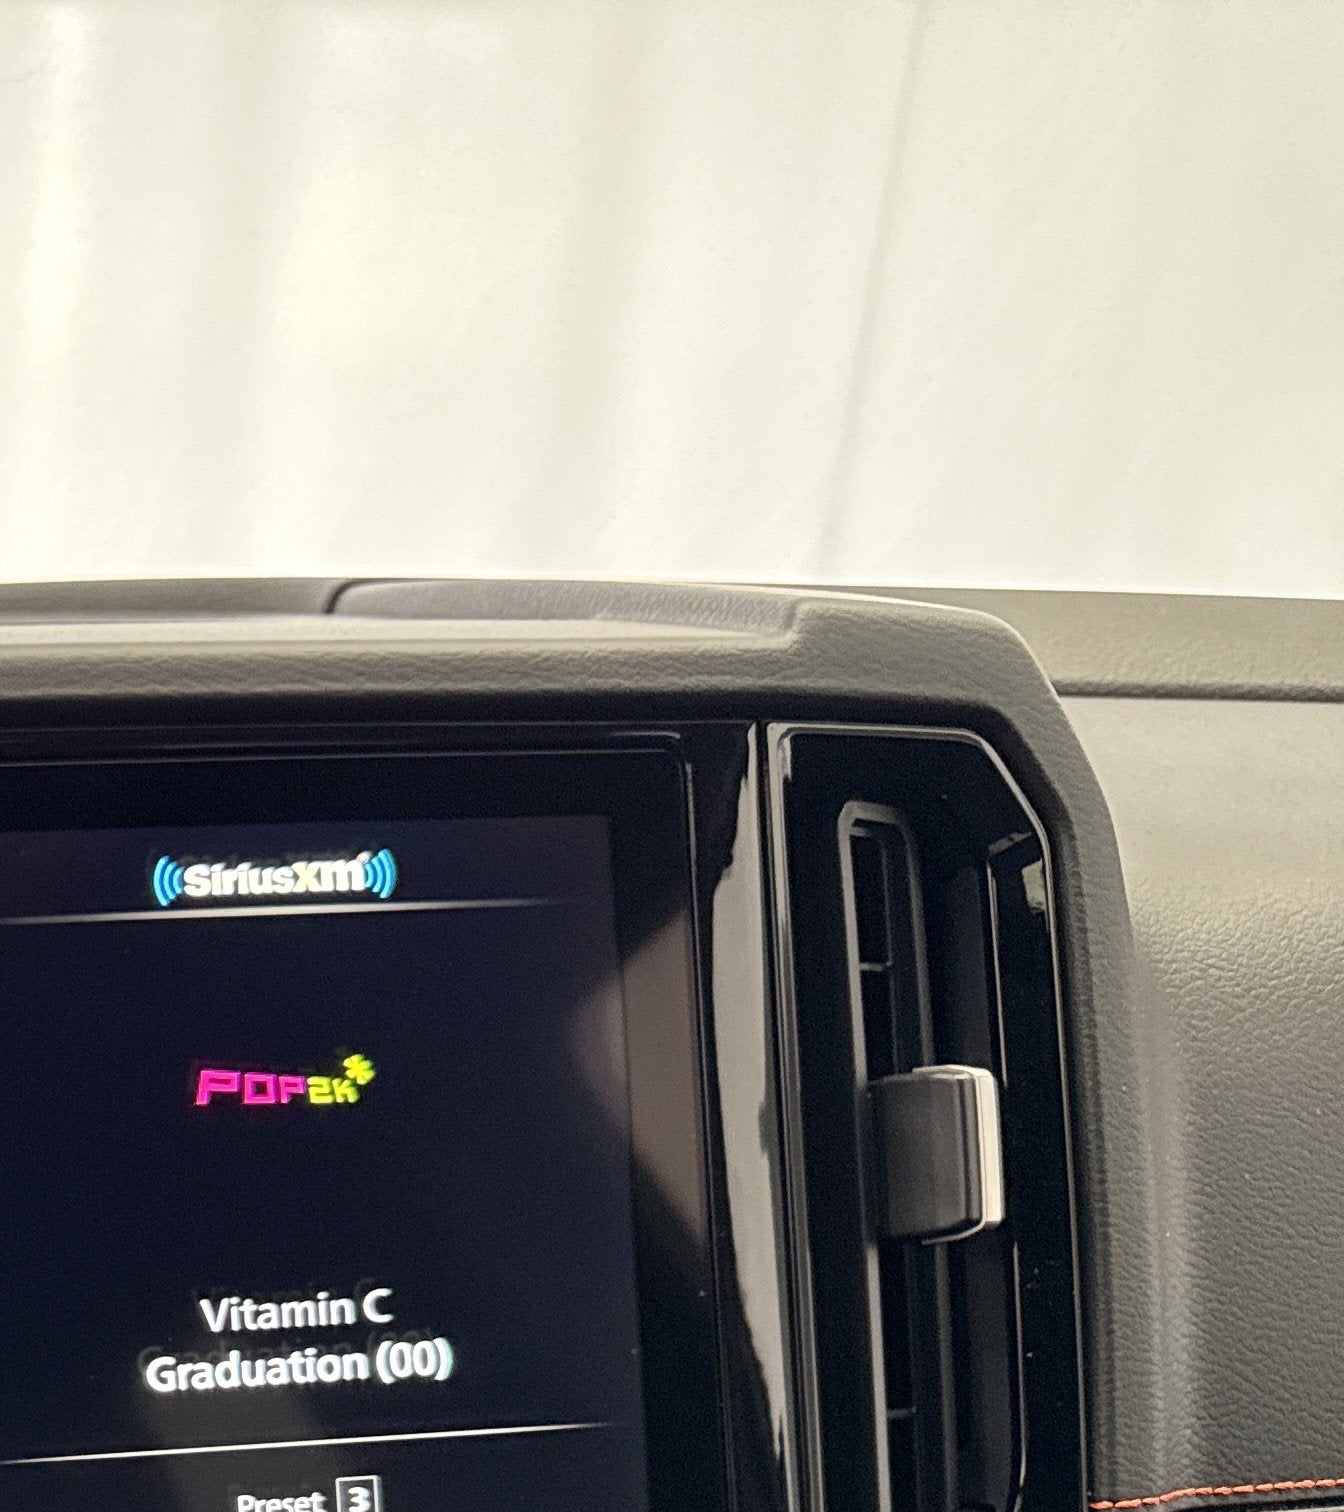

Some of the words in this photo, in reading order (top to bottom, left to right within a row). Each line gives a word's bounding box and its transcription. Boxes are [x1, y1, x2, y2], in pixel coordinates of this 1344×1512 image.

[199, 1292, 354, 1335] Vitamin
[363, 1288, 395, 1325] C
[144, 1347, 369, 1394] Graduation
[375, 1336, 453, 1381] (00)
